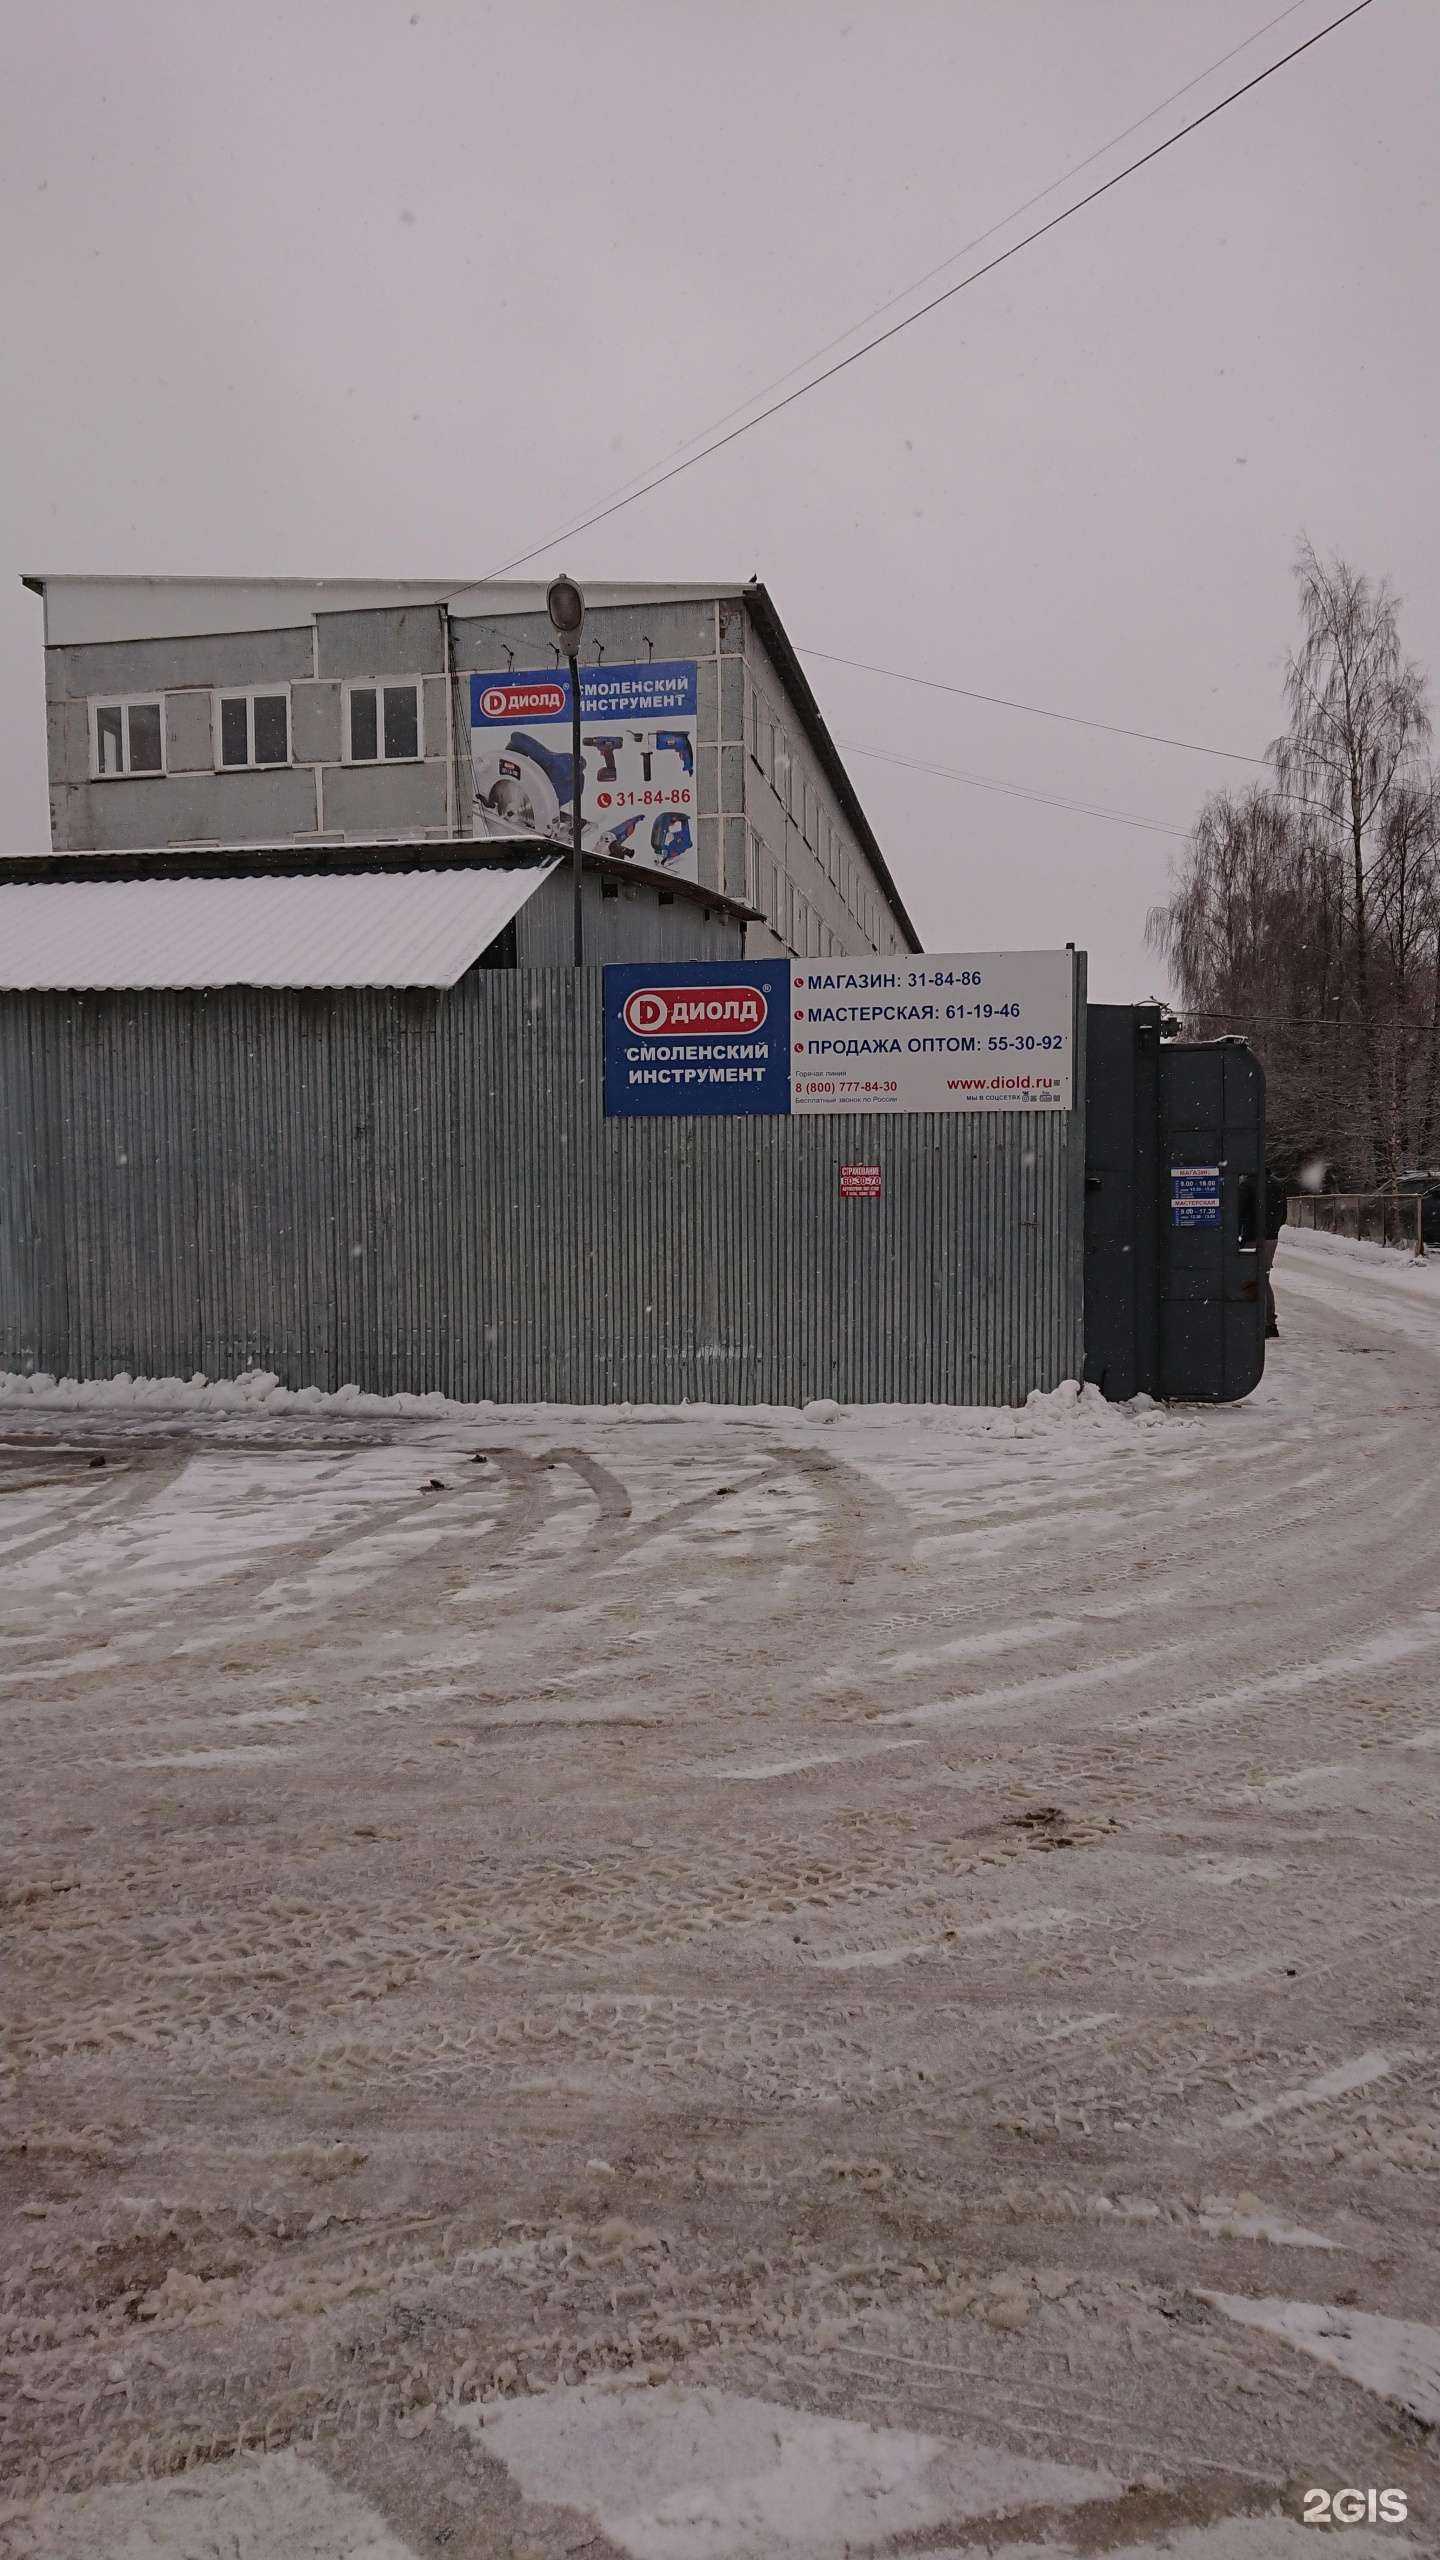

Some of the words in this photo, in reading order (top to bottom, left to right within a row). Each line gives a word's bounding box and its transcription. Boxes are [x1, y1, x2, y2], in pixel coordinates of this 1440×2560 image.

[508, 692, 561, 710] ДИОЛД
[616, 789, 691, 806] 31-84-86
[807, 973, 902, 990] МАГАЗИН:
[907, 971, 982, 988] 31-84-86
[671, 1000, 758, 1024] ДИОЛД
[807, 1004, 940, 1022] МАСТЕРСКАЯ:
[945, 1003, 1021, 1019] 61-19-46
[626, 1042, 769, 1062] СМОЛЕНСКИЙ
[807, 1038, 903, 1056] ПРОДАЖА
[907, 1037, 982, 1053] ОПТОМ:
[987, 1035, 1063, 1052] 55-30-92
[628, 1067, 767, 1084] ИНСТРУМЕНТ
[795, 1070, 824, 1078] Горячая
[946, 1075, 1053, 1090] www.diold.ru
[795, 1083, 802, 1093] 8
[806, 1082, 835, 1095] (800)
[839, 1081, 897, 1093] 777-84-30
[872, 1095, 898, 1103] России
